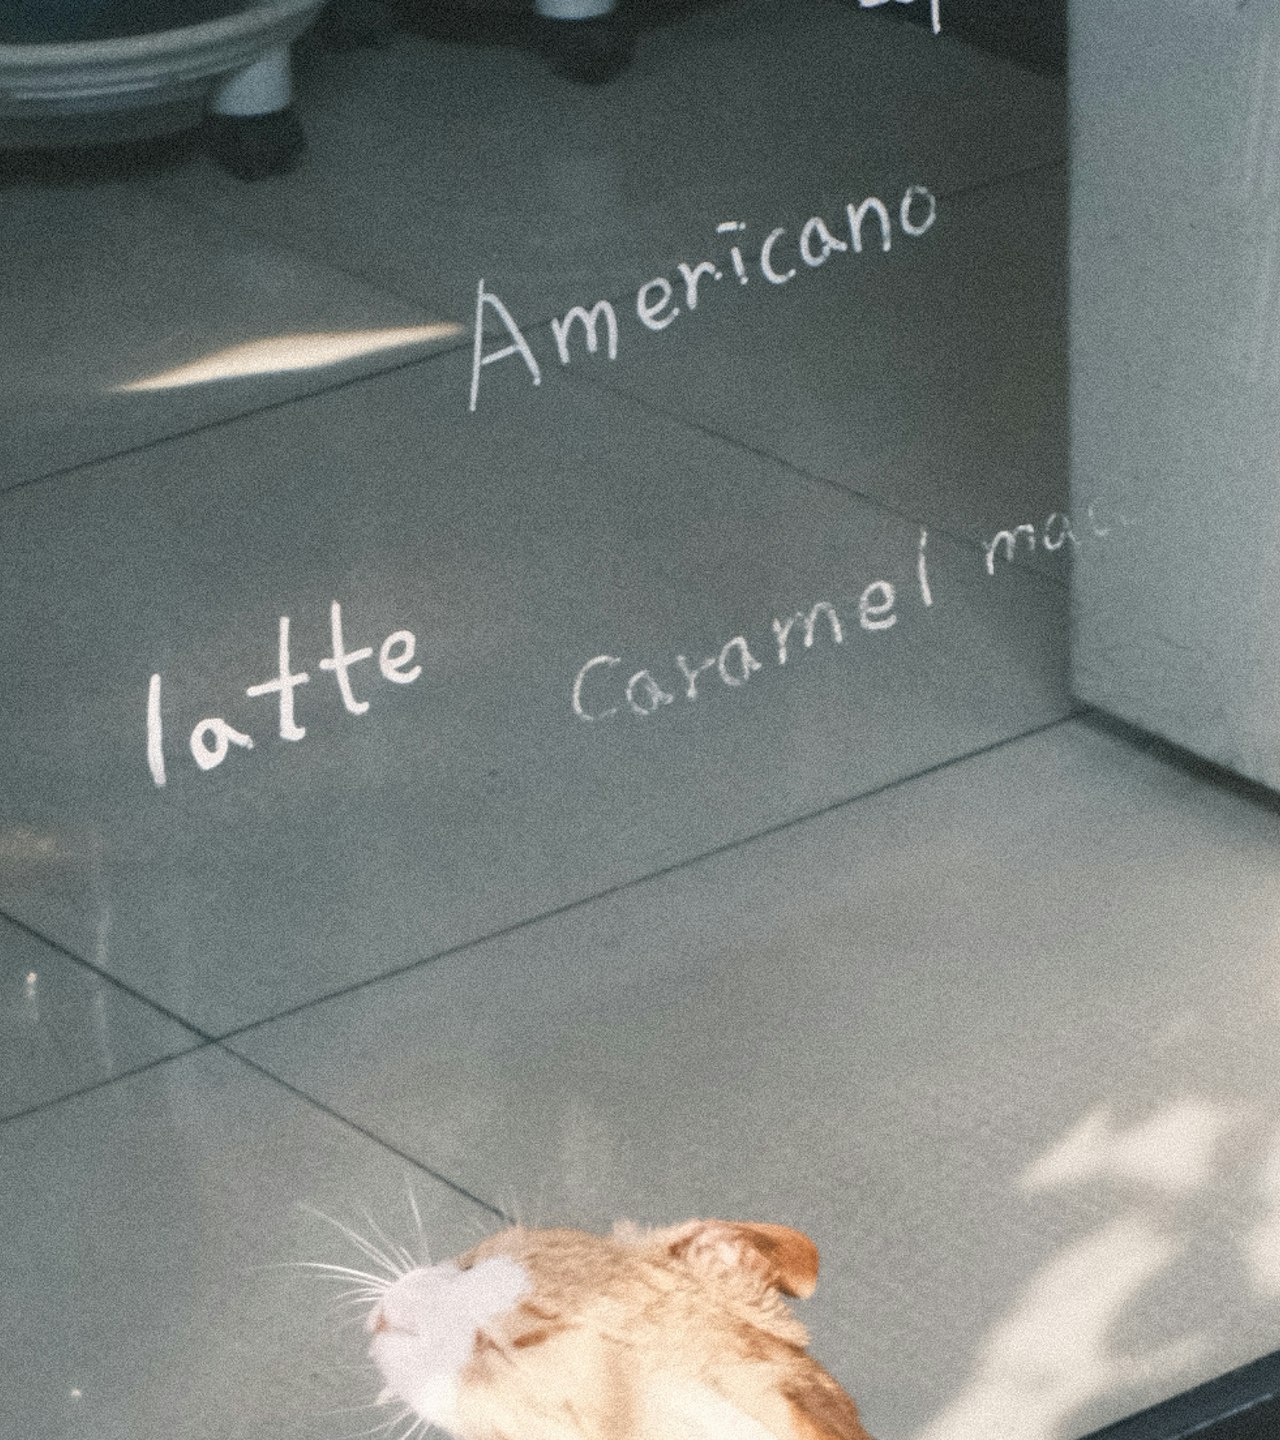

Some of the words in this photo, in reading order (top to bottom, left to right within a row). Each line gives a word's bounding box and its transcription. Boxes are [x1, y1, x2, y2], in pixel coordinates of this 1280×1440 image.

[468, 183, 937, 412] Americano
[146, 598, 423, 788] latte
[572, 526, 933, 721] Caramel
